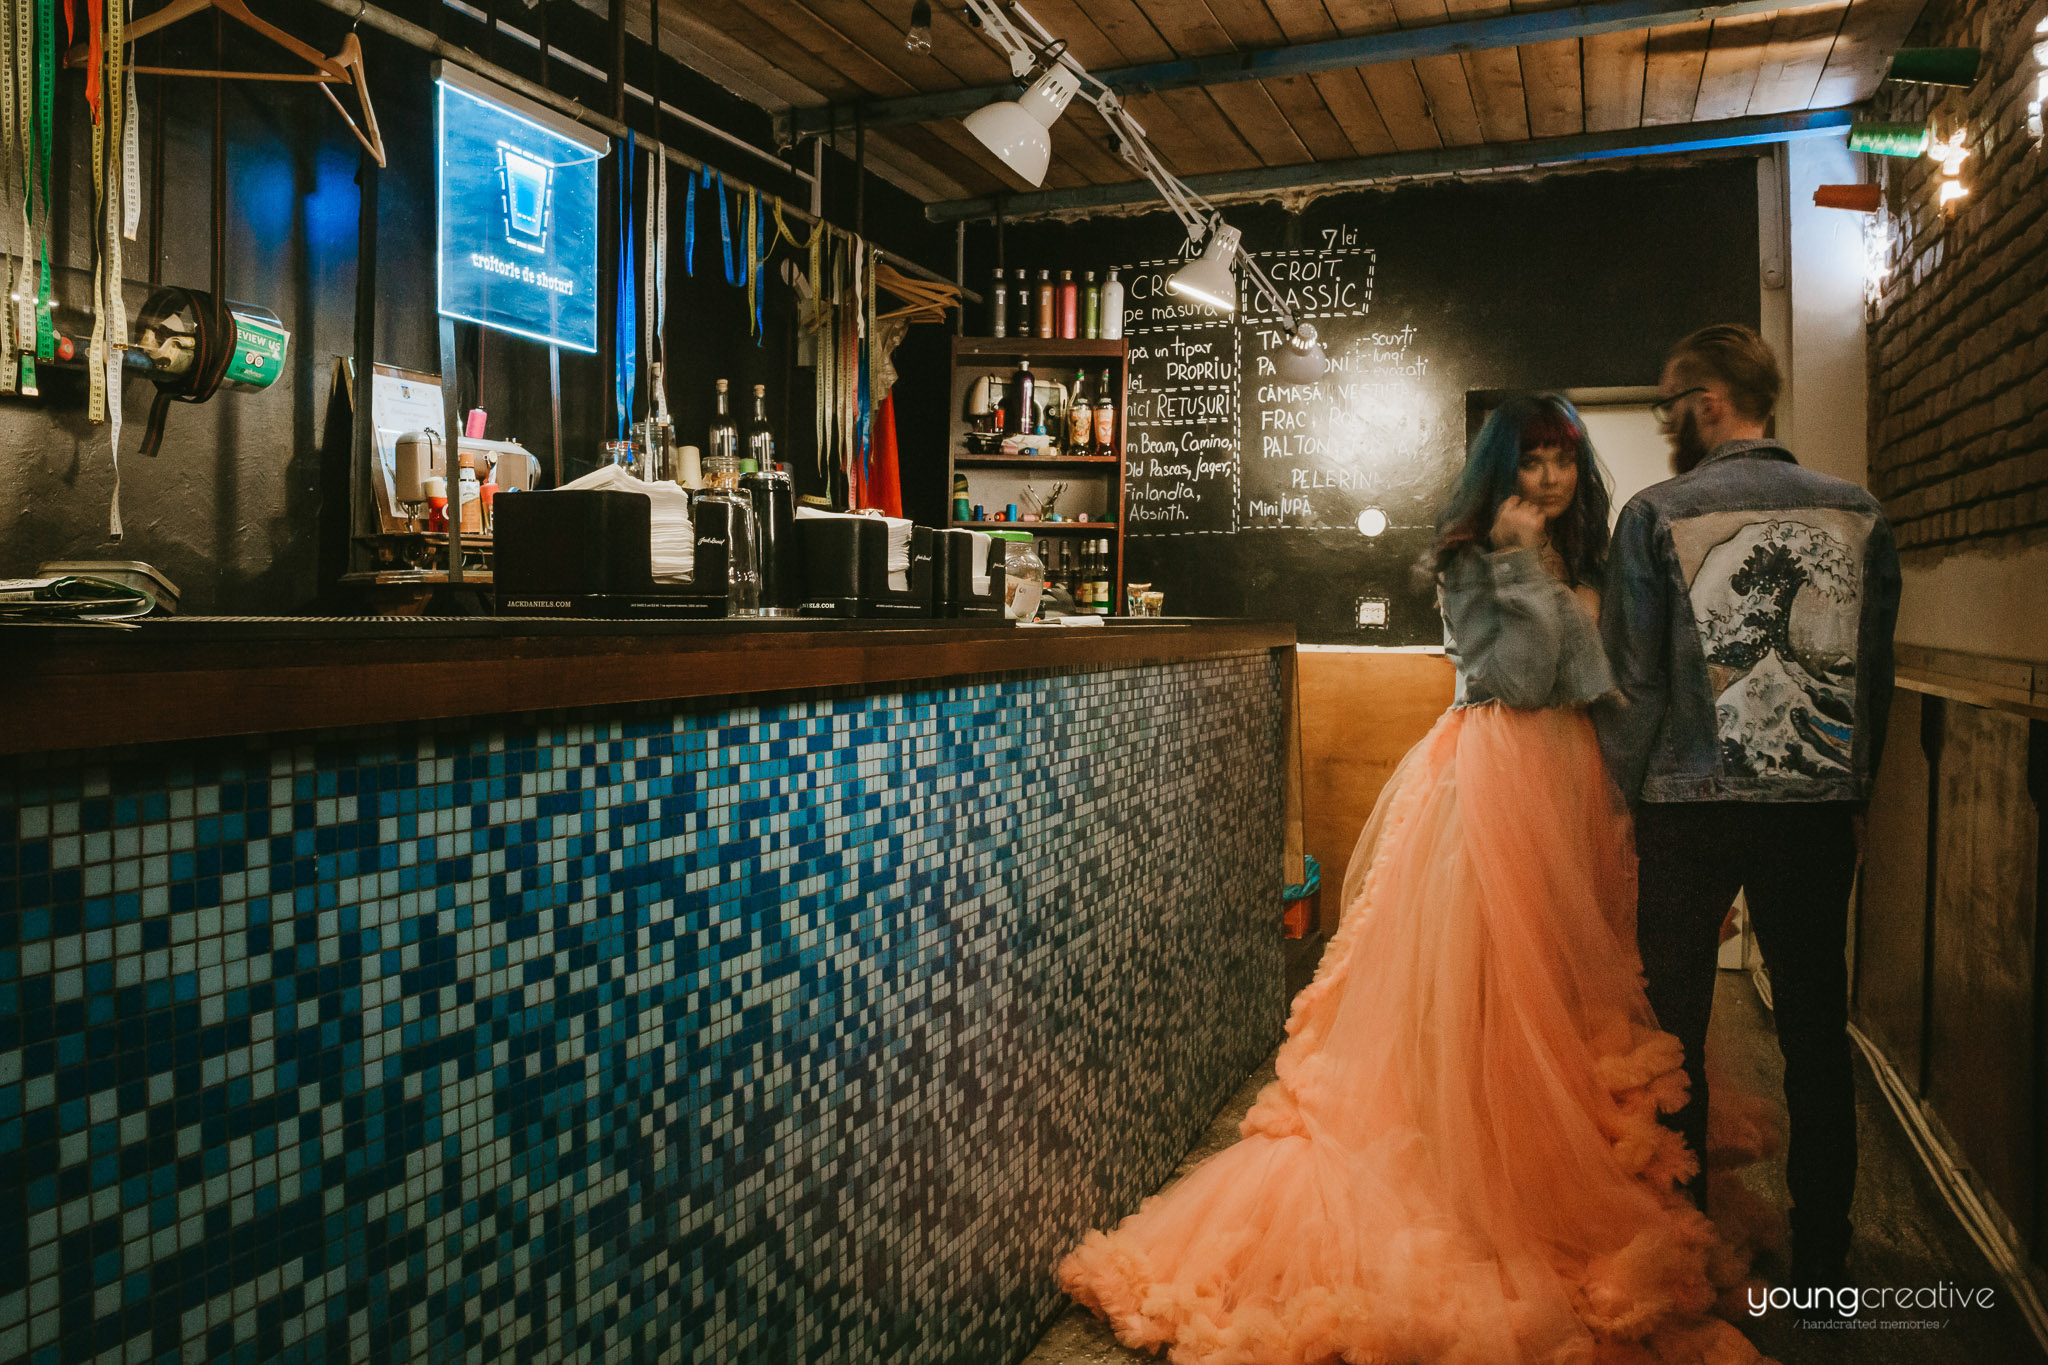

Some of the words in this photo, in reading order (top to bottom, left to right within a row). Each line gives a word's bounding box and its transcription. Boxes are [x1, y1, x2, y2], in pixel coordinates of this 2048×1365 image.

[1321, 229, 1338, 249] 7
[1342, 223, 1358, 245] lei
[521, 266, 536, 284] de
[1255, 276, 1357, 313] CLASSIC
[1124, 308, 1144, 327] pe
[236, 328, 267, 346] EVIEW
[268, 339, 281, 352] US
[1155, 347, 1169, 358] un
[1170, 335, 1213, 364] tipar
[1128, 373, 1143, 389] lei
[1141, 432, 1179, 457] Beam,
[1181, 431, 1233, 451] Camino,
[1129, 503, 1189, 521] Absinth.
[507, 600, 571, 608] JACKDANIELS.COM
